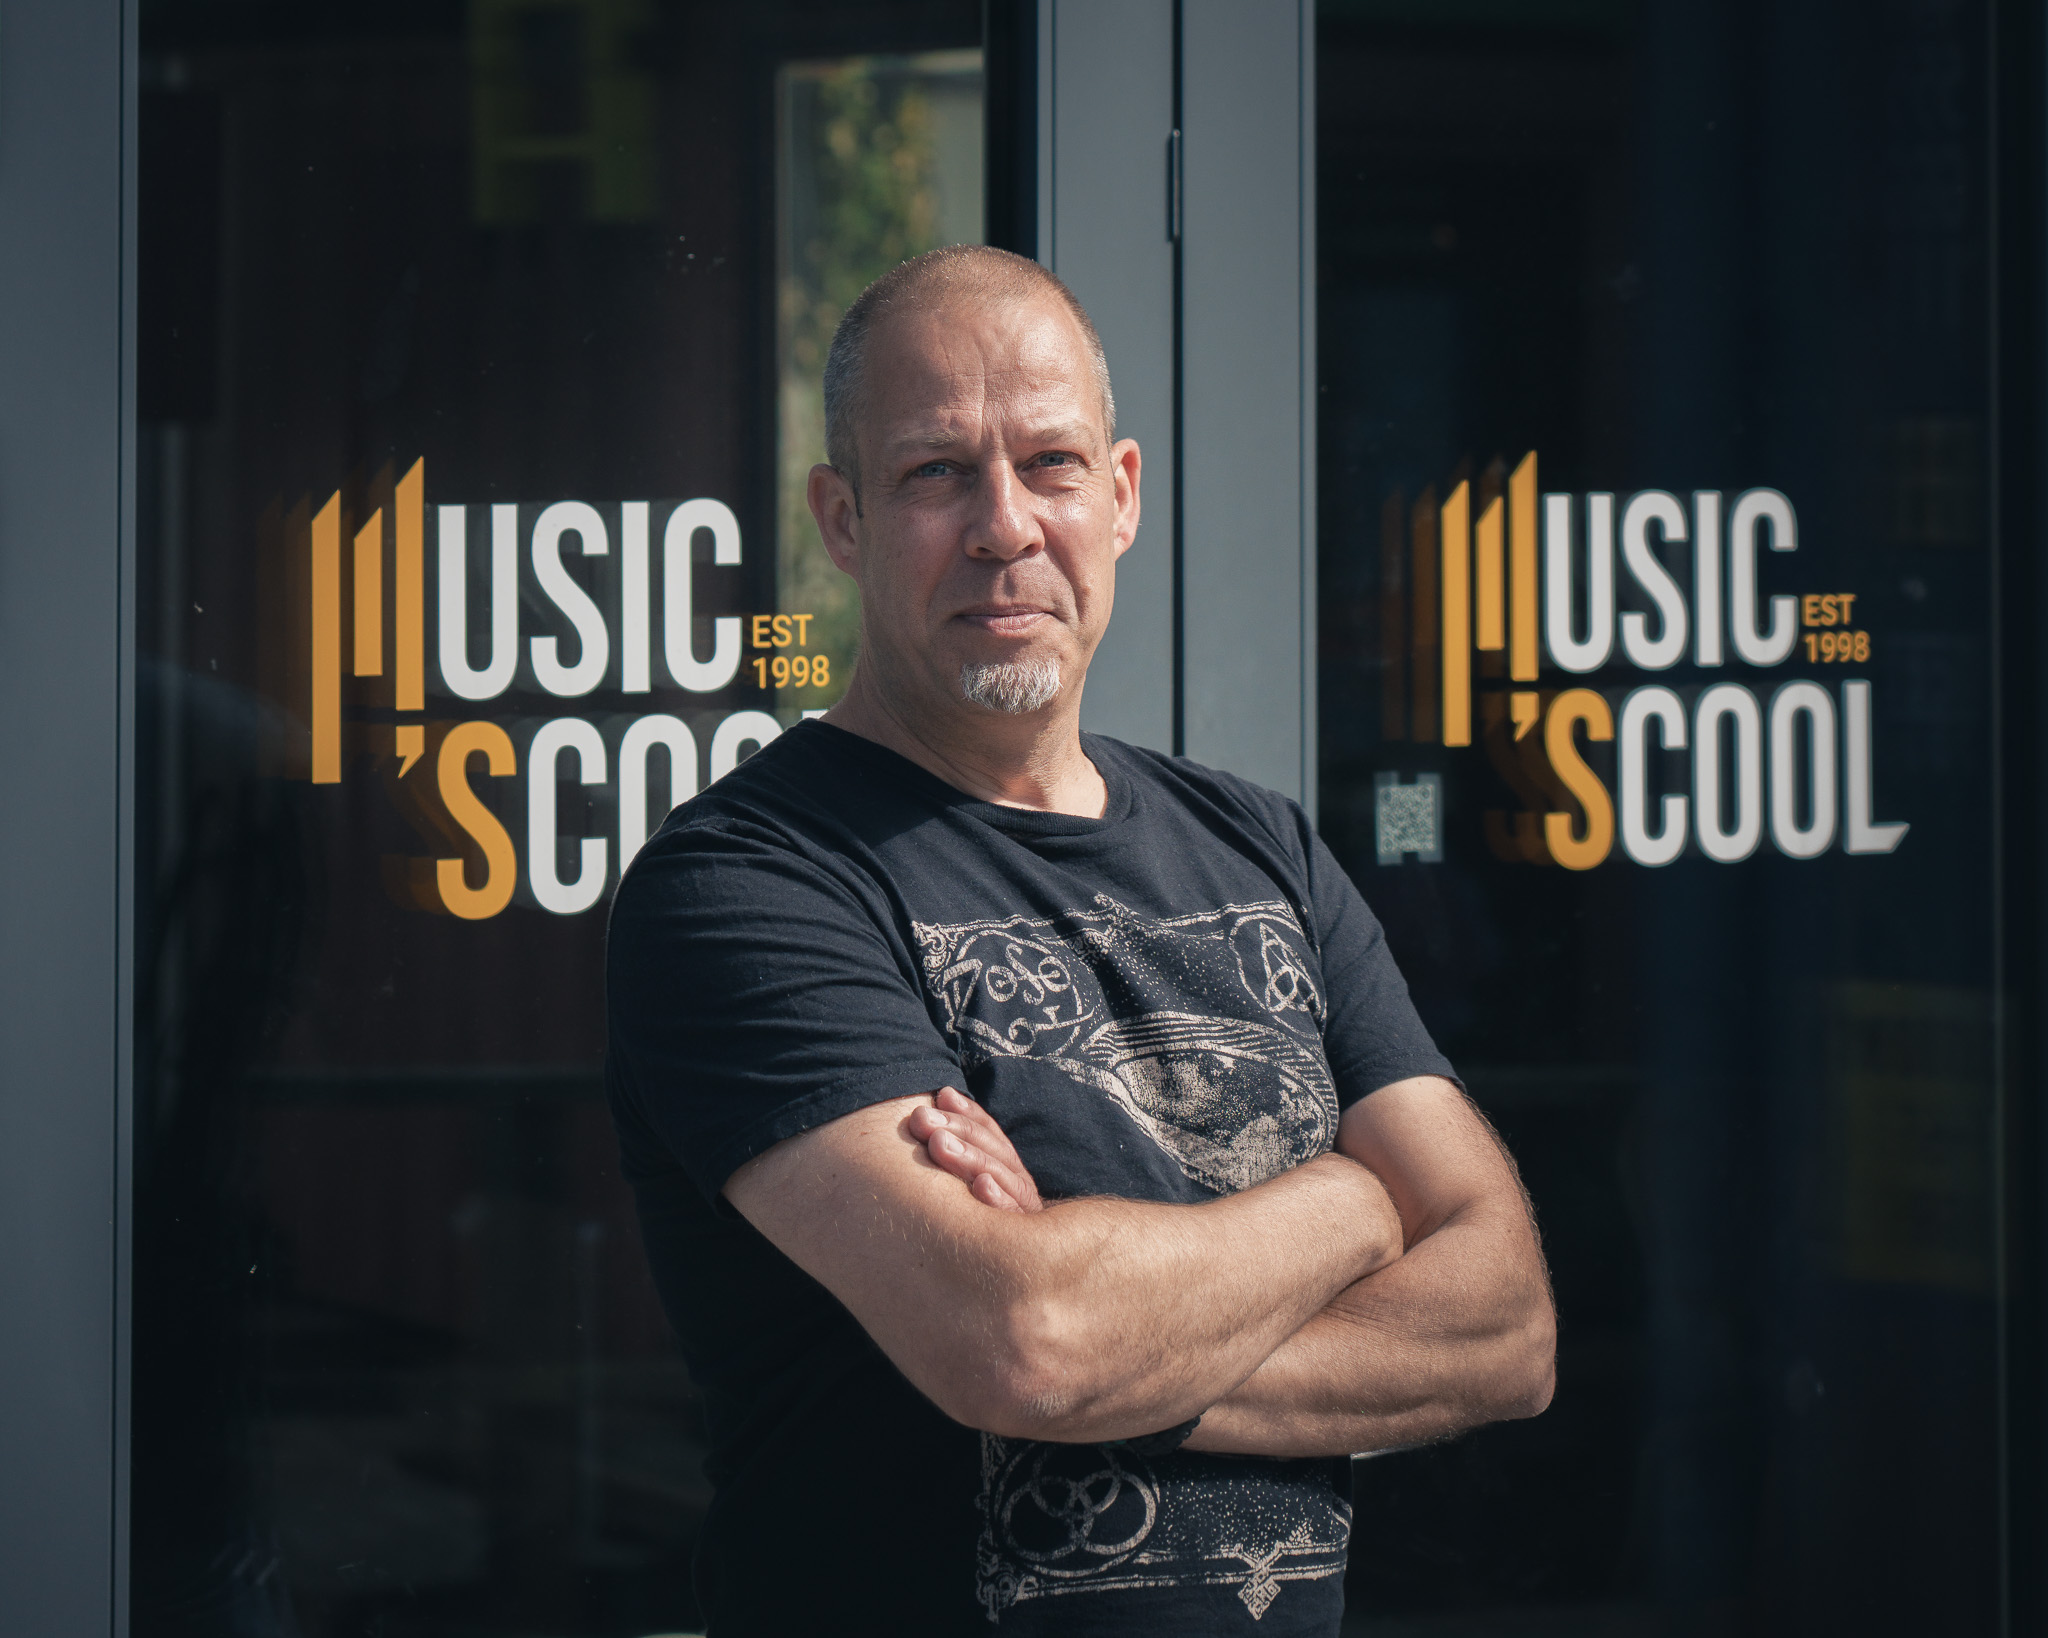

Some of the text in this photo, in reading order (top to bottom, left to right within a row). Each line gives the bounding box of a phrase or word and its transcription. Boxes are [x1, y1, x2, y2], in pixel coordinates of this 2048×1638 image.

[1804, 594, 1856, 626] EST
[751, 614, 814, 648] EST
[1805, 631, 1871, 663] 1998
[752, 655, 830, 689] 1998
